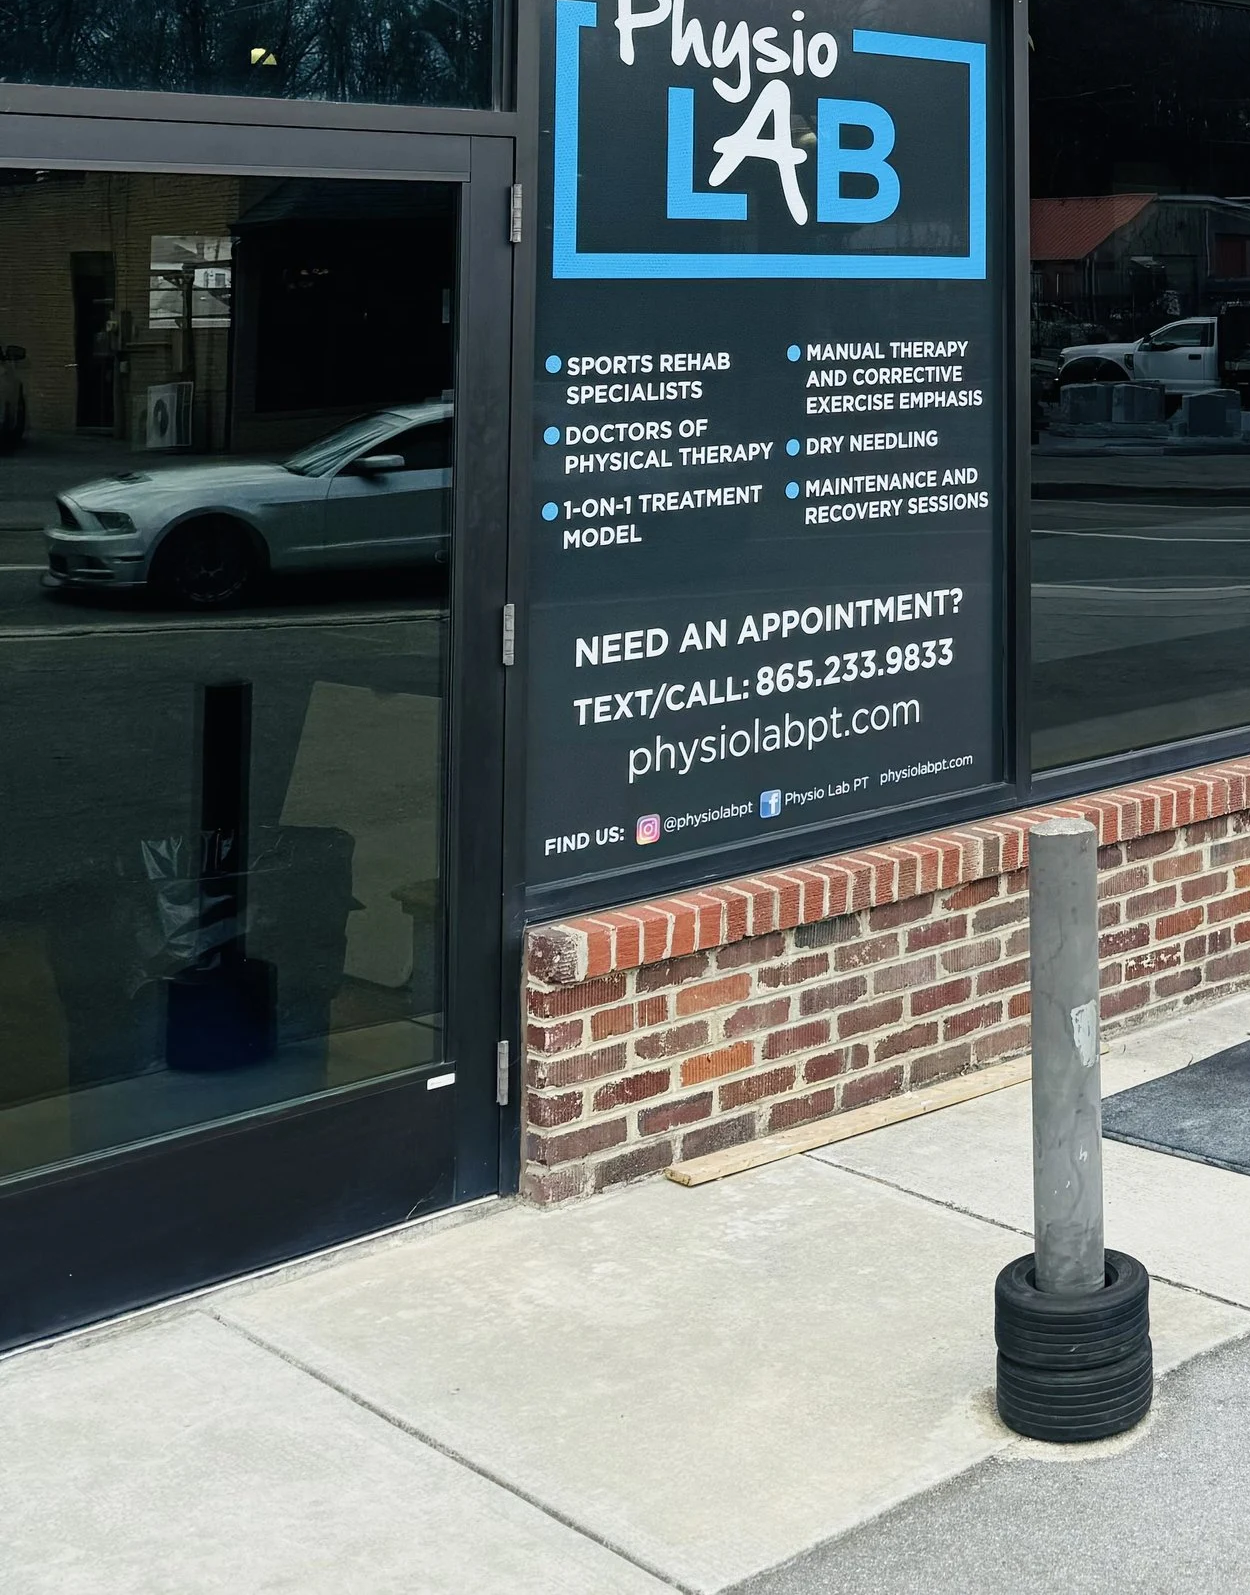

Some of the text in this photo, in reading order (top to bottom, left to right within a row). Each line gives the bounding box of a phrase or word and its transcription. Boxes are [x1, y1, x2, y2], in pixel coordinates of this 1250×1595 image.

[667, 79, 900, 225] LAB
[567, 353, 730, 375] SPORTS REHAB
[807, 341, 968, 361] MANUAL THERAPY
[806, 366, 962, 388] AND CORRECTIVE
[567, 381, 702, 404] SPECIALISTS
[807, 390, 982, 414] EXERCISE EMPHASIS
[566, 419, 708, 445] DOCTORS OF
[807, 430, 938, 455] DRY NEEDLING
[566, 442, 773, 474] PHYSICAL THERAPY
[806, 468, 978, 497] MAINTENANCE AND
[564, 485, 762, 519] 1-ON-1 TREATMENT
[805, 492, 988, 524] RECOVERY SESSIONS
[564, 524, 642, 549] MODEL
[576, 588, 963, 667] NEED AN APPOINTMENT?
[574, 638, 953, 726] TEXT/CALL: 865.233.9833
[629, 697, 920, 784] physiolabpt.com
[881, 755, 972, 785] physiolabpt.com
[785, 776, 869, 805] Physio Lab PT
[664, 802, 753, 832] @physiolabpt
[545, 826, 624, 855] FIND US:
